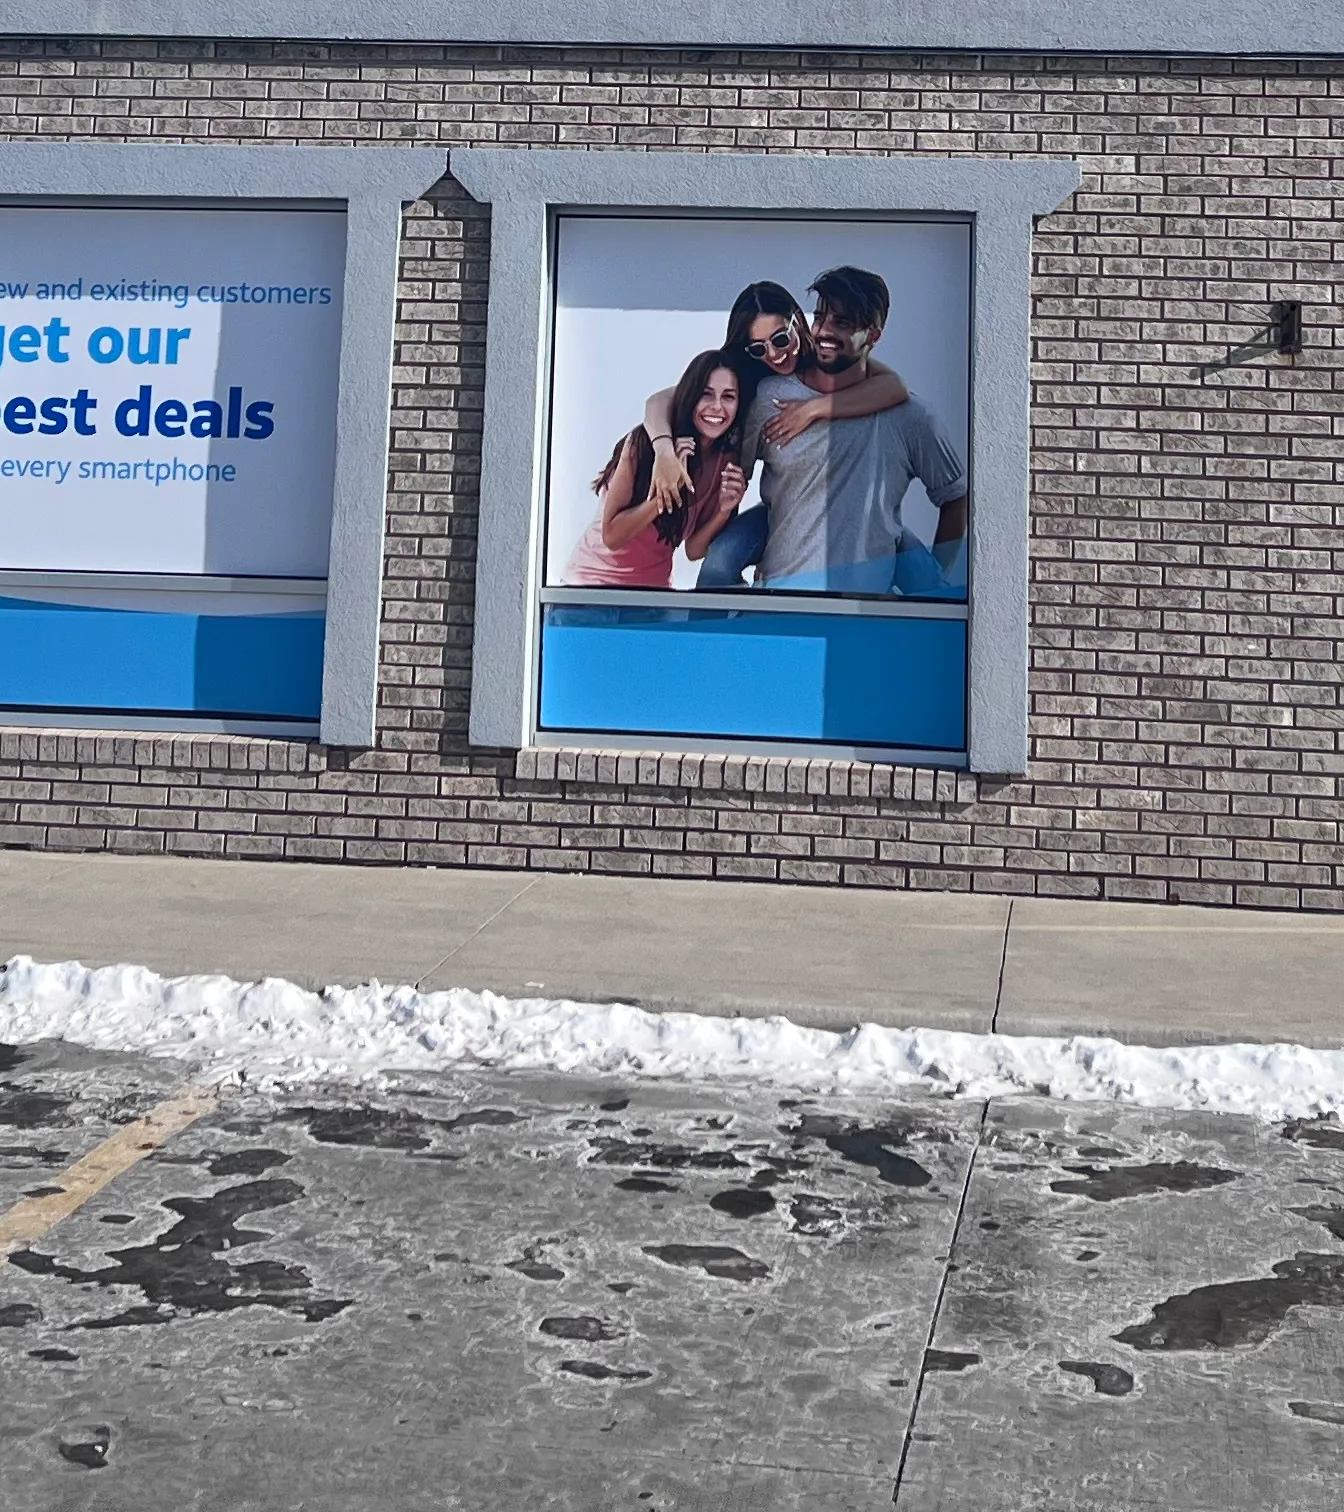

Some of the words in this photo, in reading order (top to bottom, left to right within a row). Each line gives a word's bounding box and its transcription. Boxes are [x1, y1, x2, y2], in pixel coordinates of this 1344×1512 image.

[35, 278, 84, 301] and
[90, 279, 190, 309] existing
[197, 283, 332, 305] customers
[87, 326, 192, 365] our
[114, 385, 276, 440] deals
[0, 459, 72, 484] every
[78, 457, 237, 487] smartphone
